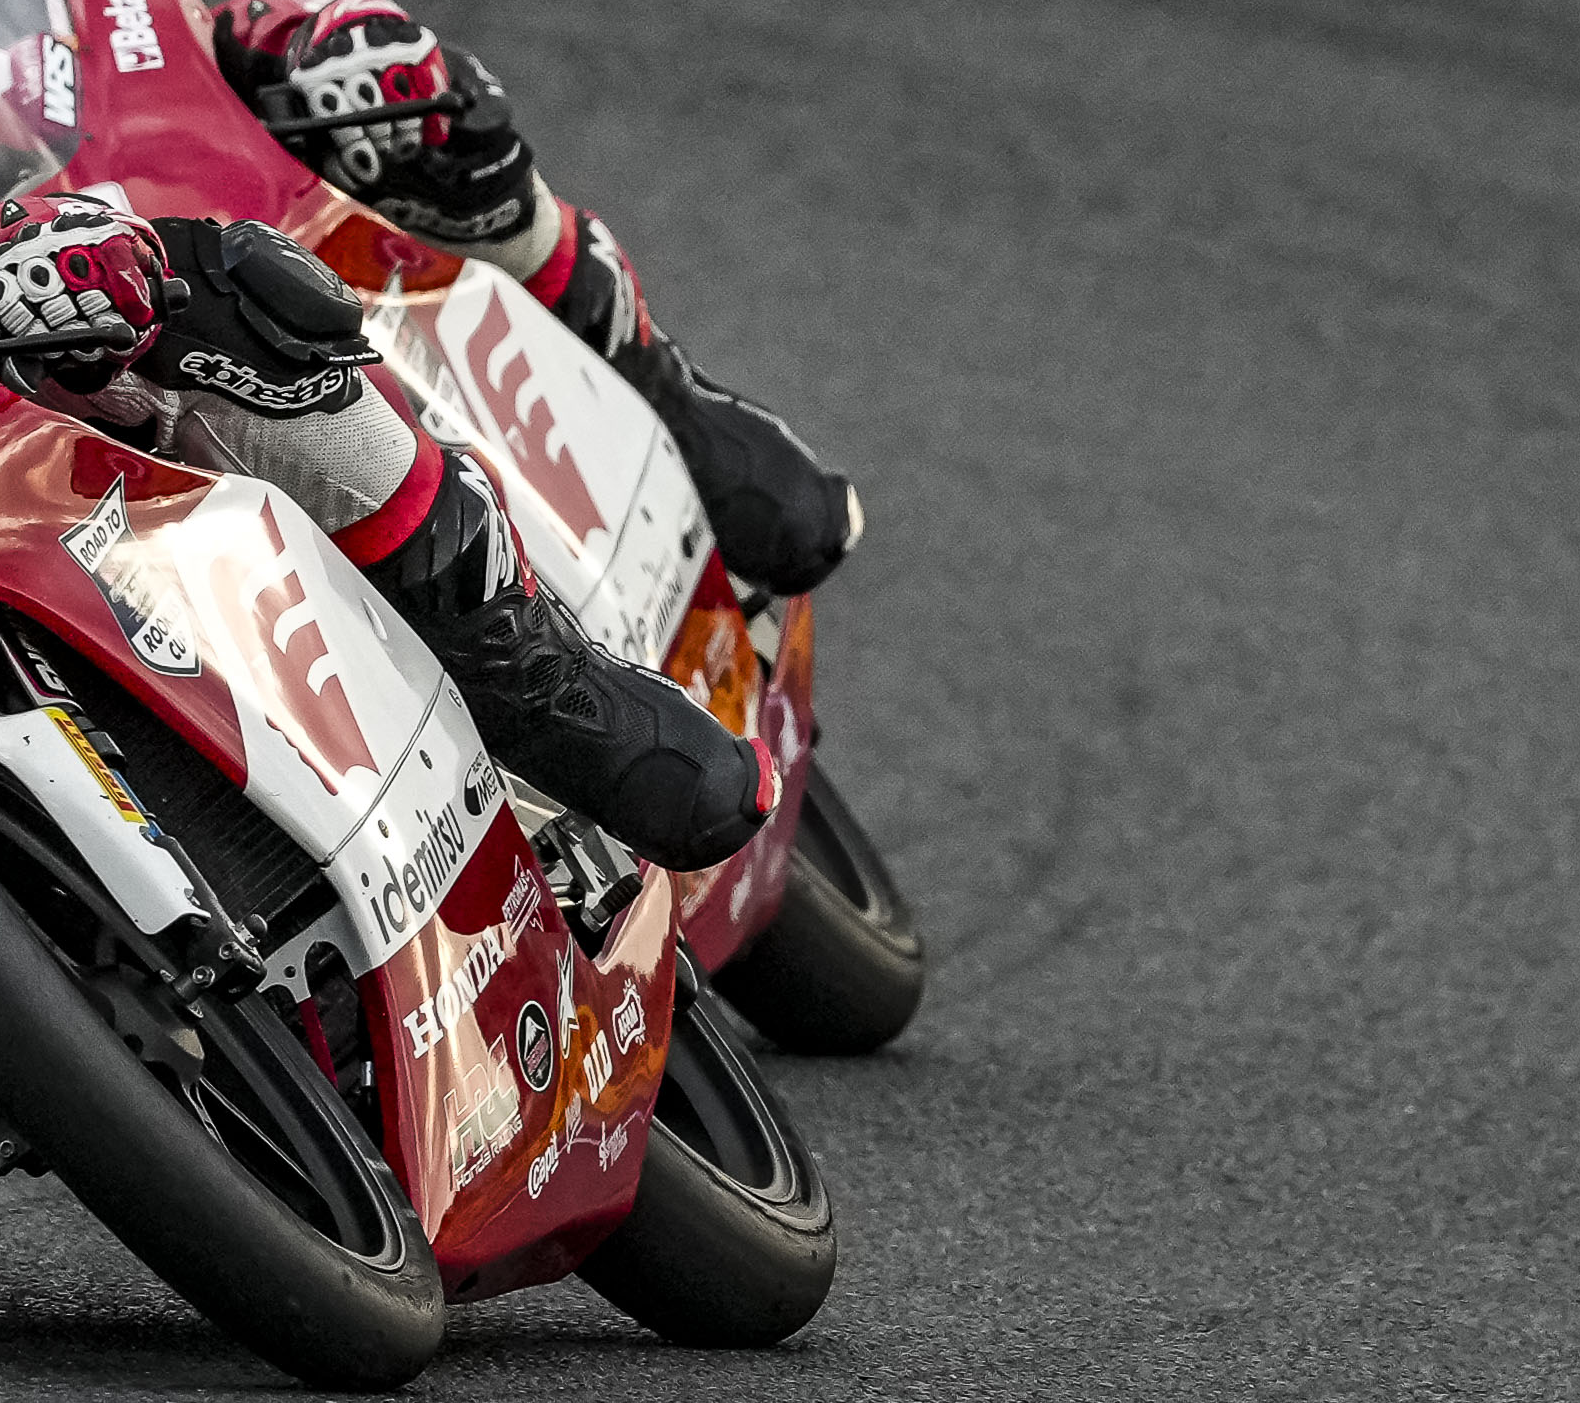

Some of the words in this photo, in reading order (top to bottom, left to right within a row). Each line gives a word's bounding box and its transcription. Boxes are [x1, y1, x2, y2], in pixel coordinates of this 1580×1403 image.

[79, 524, 109, 565] ROAD
[106, 508, 122, 535] TO
[143, 617, 175, 654] ROOK
[169, 638, 187, 661] CU
[360, 802, 465, 945] idemitsu
[403, 925, 506, 1059] HONDA
